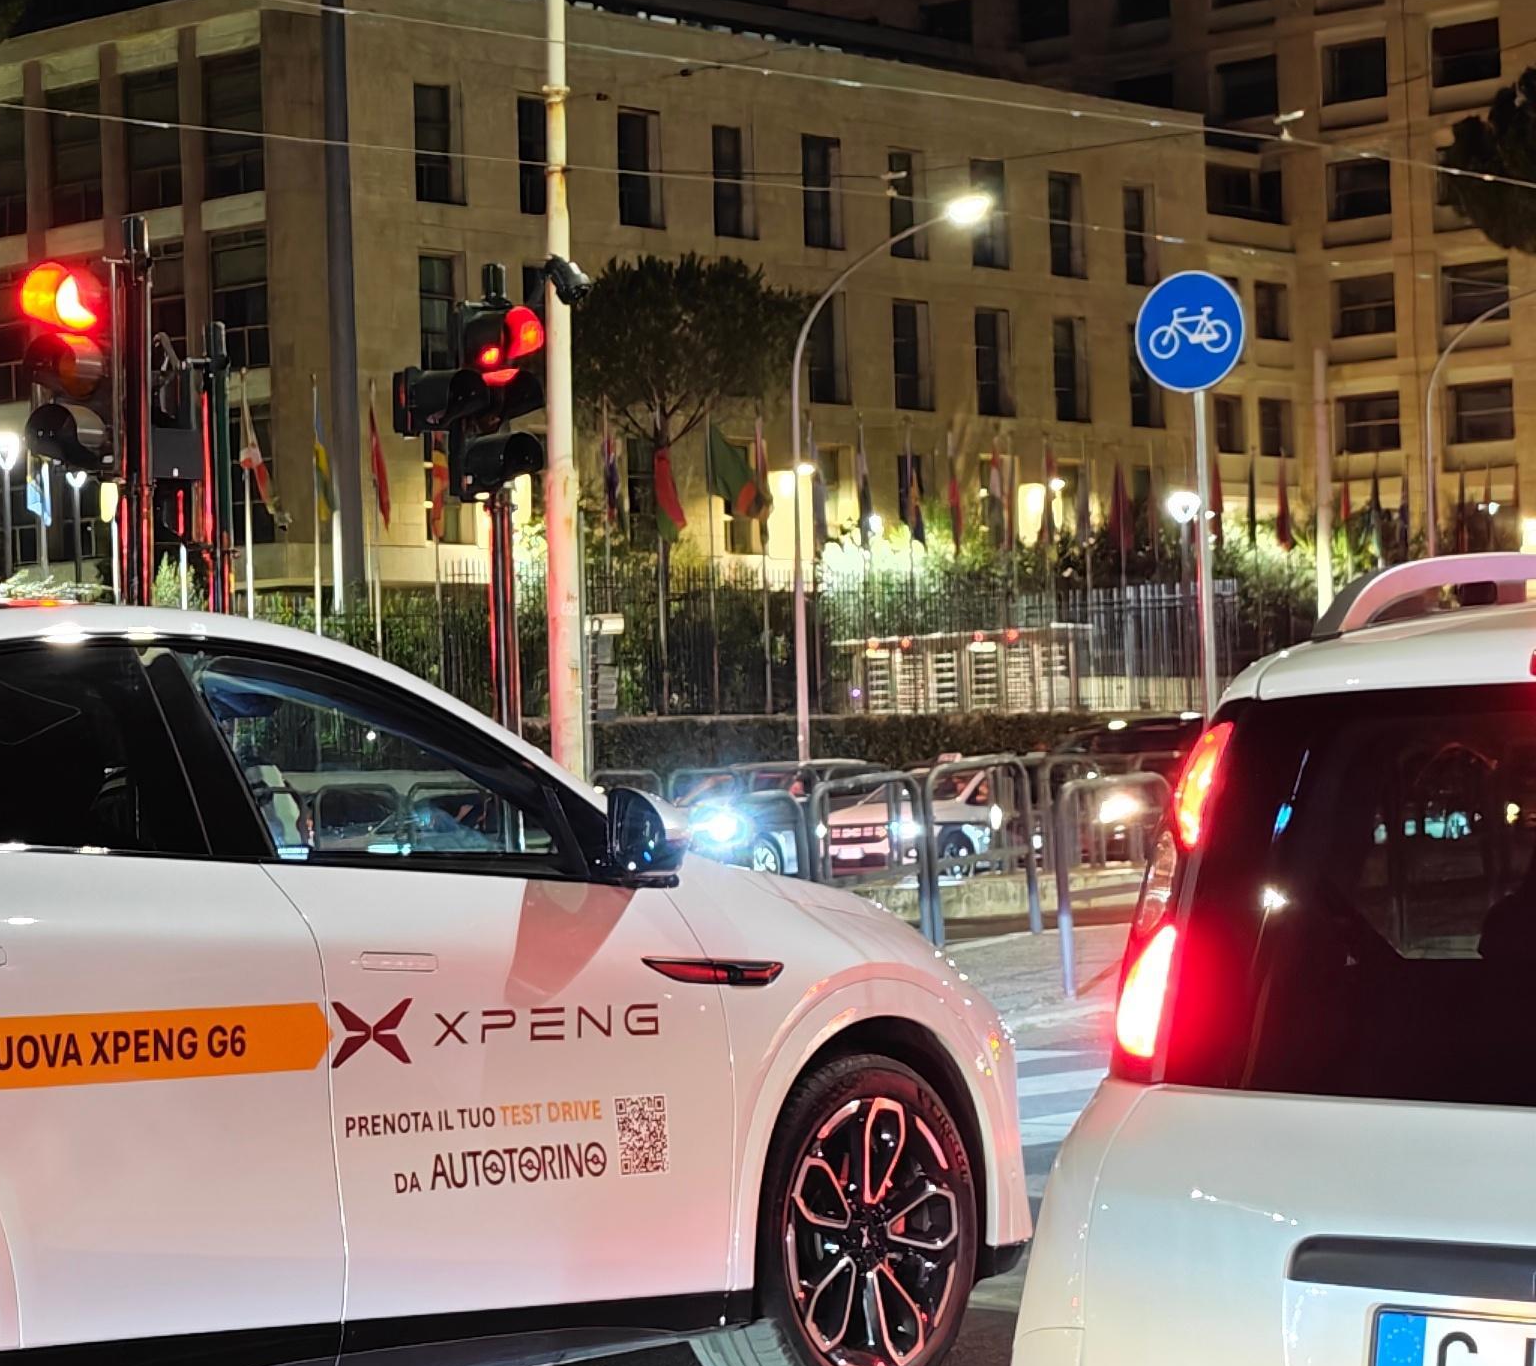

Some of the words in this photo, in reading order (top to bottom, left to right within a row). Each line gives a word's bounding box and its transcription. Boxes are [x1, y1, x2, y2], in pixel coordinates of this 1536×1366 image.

[90, 1027, 198, 1065] XPENG
[207, 1024, 247, 1058] G6
[433, 1003, 659, 1046] XPENG
[345, 1111, 434, 1137] PRENOTA
[438, 1108, 455, 1132] IL
[457, 1107, 496, 1129] TUO
[499, 1102, 543, 1127] TEST
[547, 1099, 603, 1123] DRIVE
[394, 1171, 422, 1194] DA
[430, 1141, 608, 1191] AUTOTORINO
